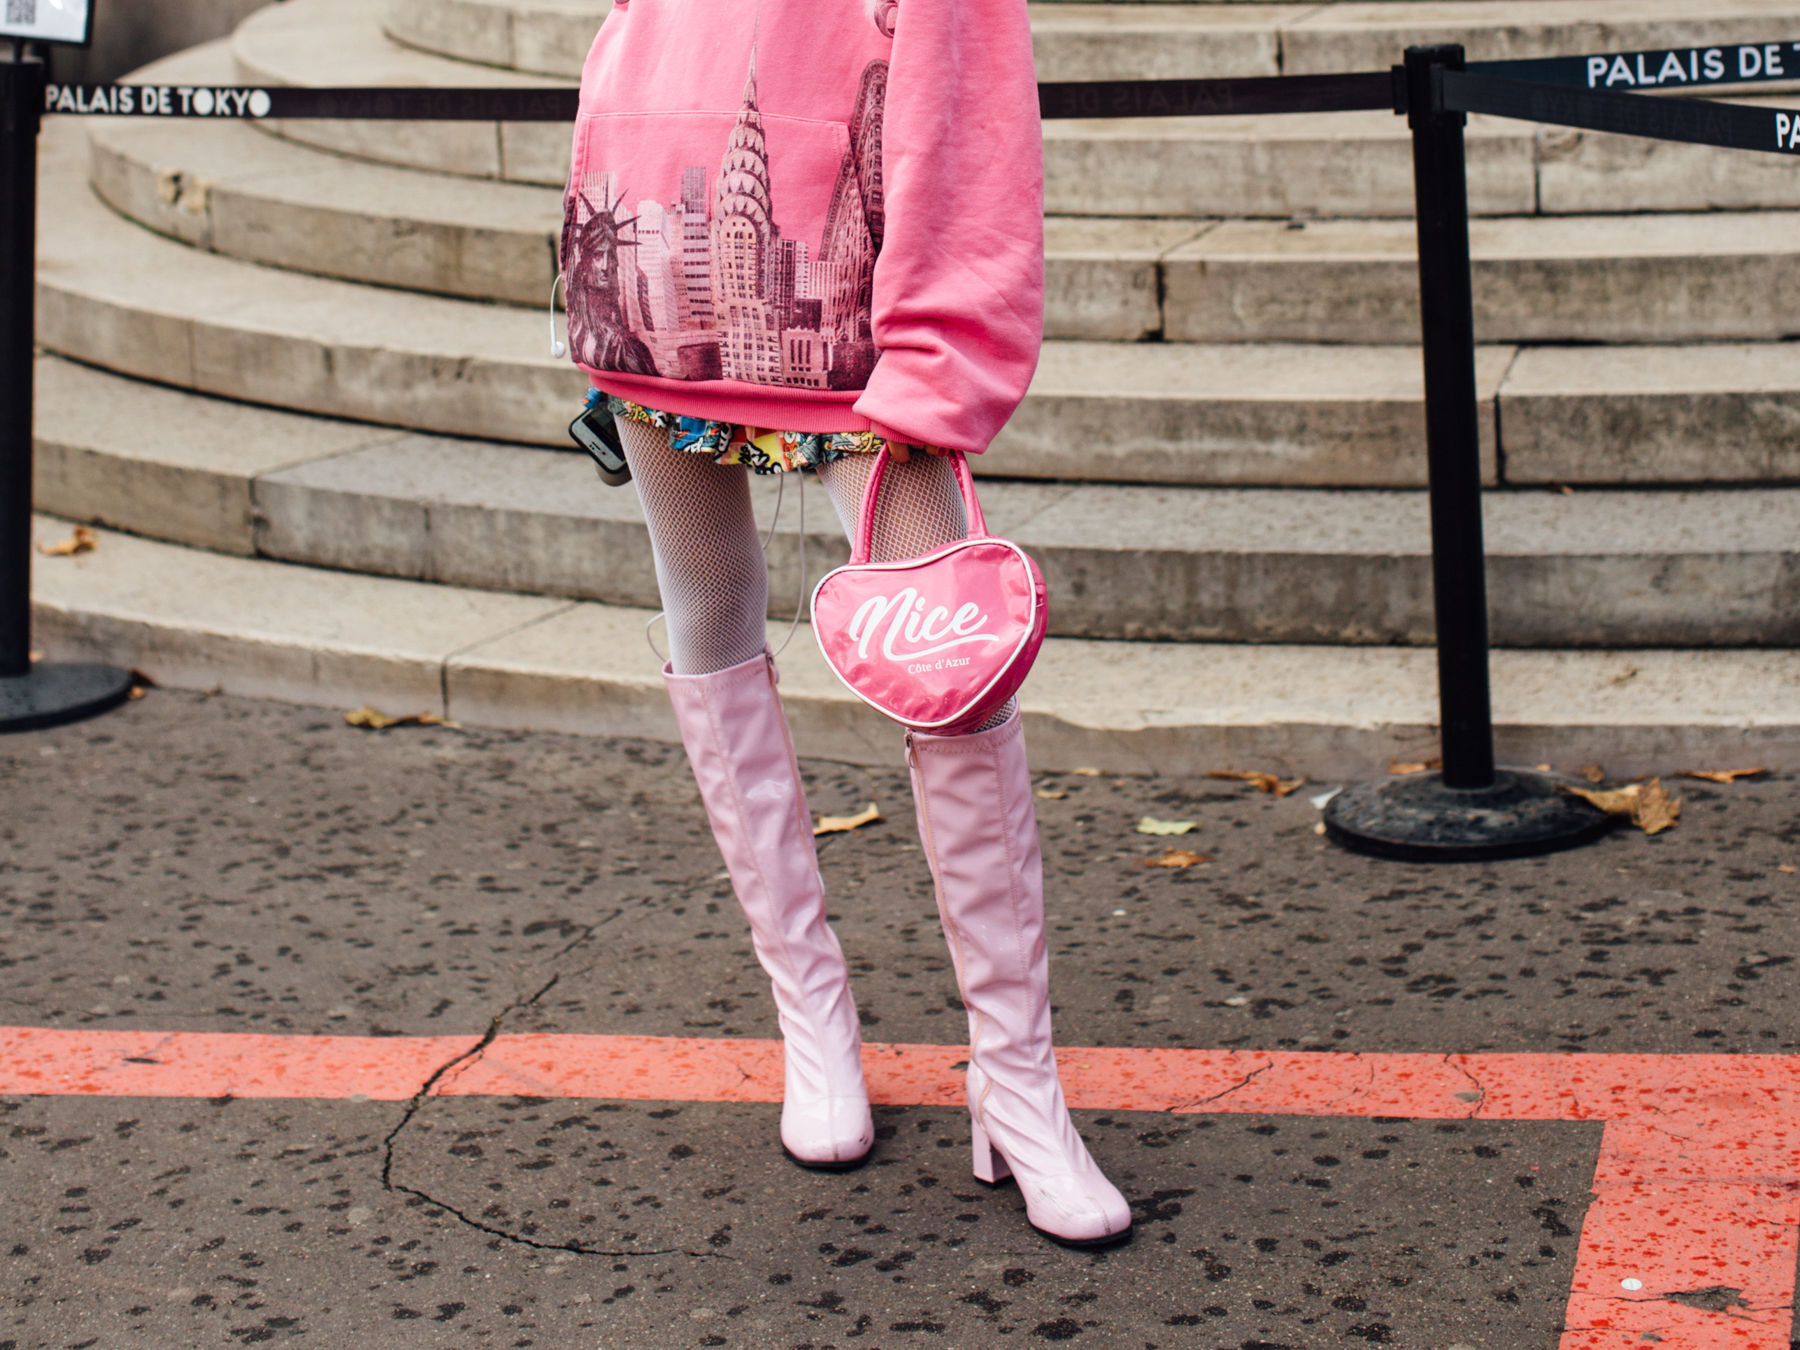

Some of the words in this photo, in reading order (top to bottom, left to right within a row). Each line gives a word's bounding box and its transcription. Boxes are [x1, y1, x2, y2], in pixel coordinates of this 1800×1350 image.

[1587, 47, 1725, 89] PALAIS
[1738, 44, 1784, 78] DE
[45, 84, 134, 114] PALAIS
[141, 86, 172, 114] DE
[176, 87, 271, 118] TOKYO
[849, 587, 999, 661] Nice
[908, 661, 932, 674] Côte
[935, 657, 971, 671] d'Azur
